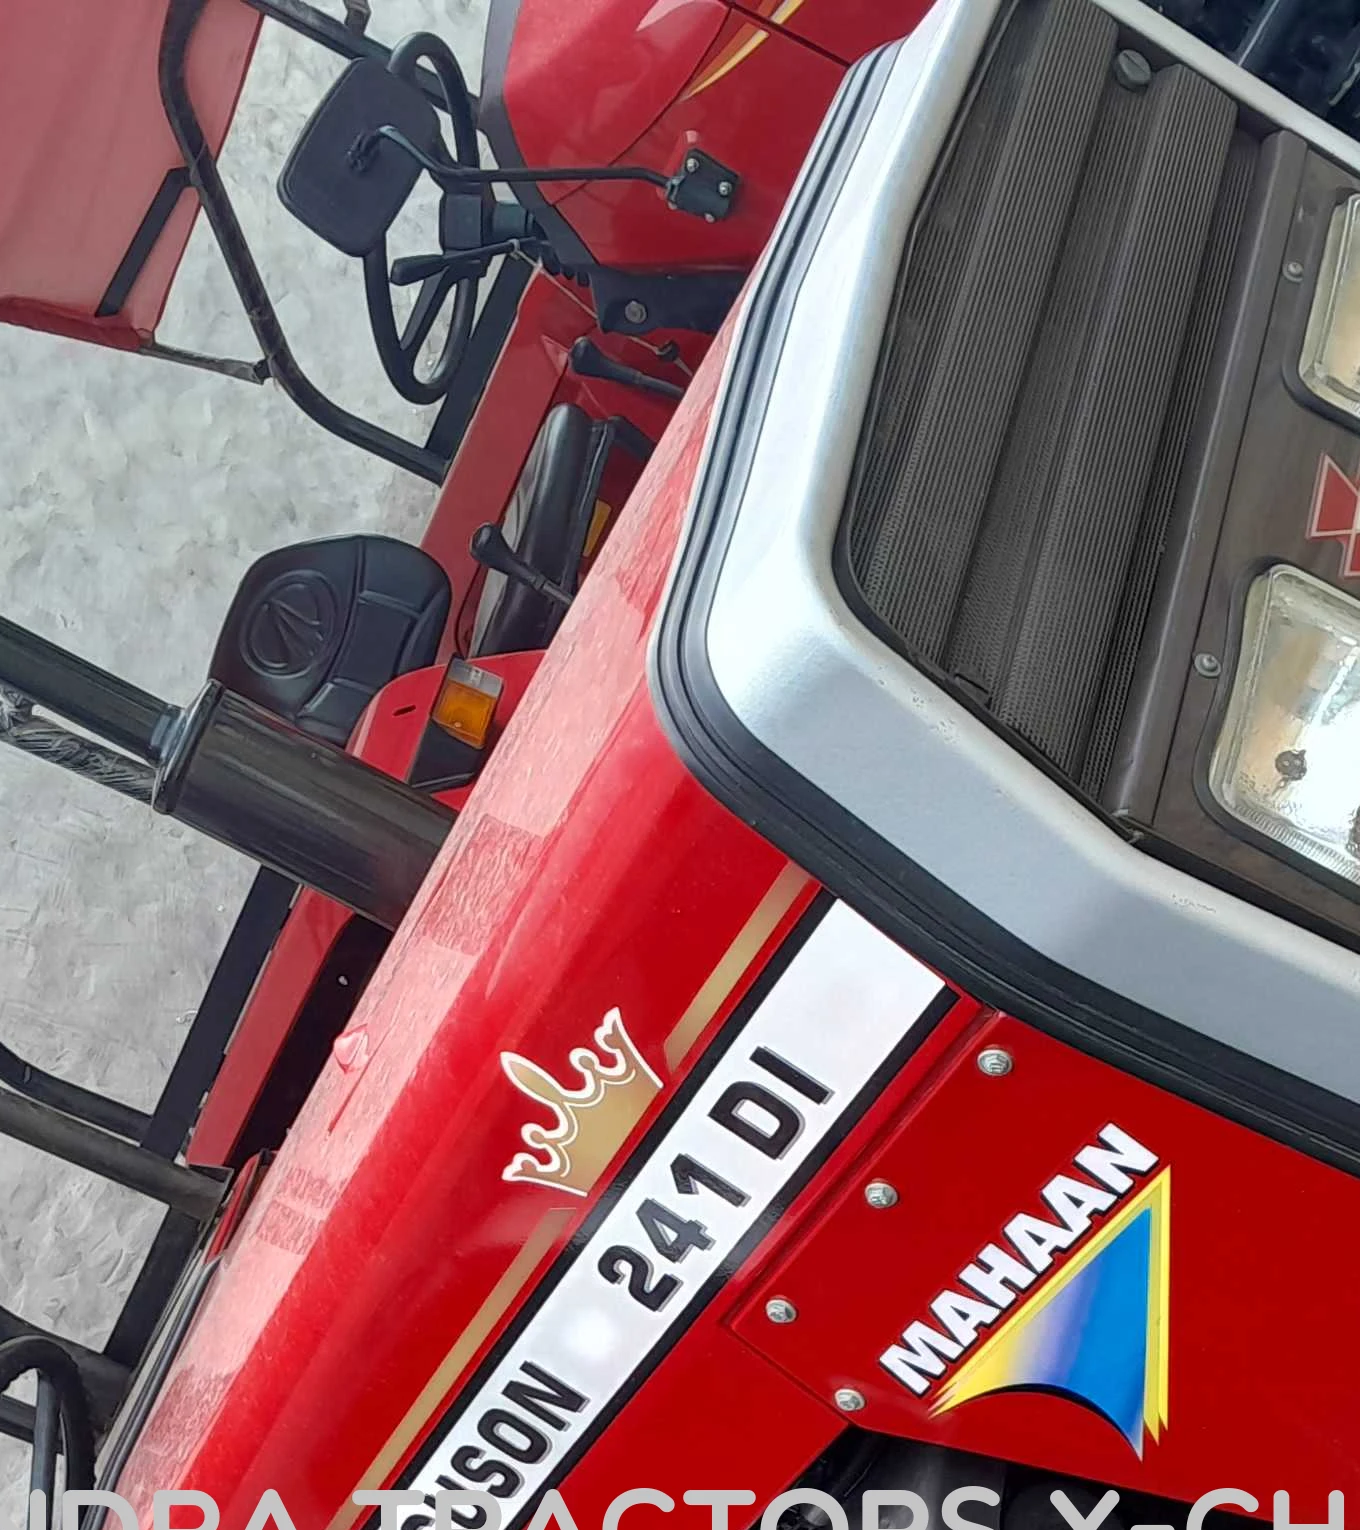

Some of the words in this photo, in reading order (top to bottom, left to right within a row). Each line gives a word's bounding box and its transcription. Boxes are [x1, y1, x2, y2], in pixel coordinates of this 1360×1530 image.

[598, 1151, 753, 1314] 241
[708, 1045, 833, 1161] DI
[876, 1121, 1163, 1398] MAHAAN
